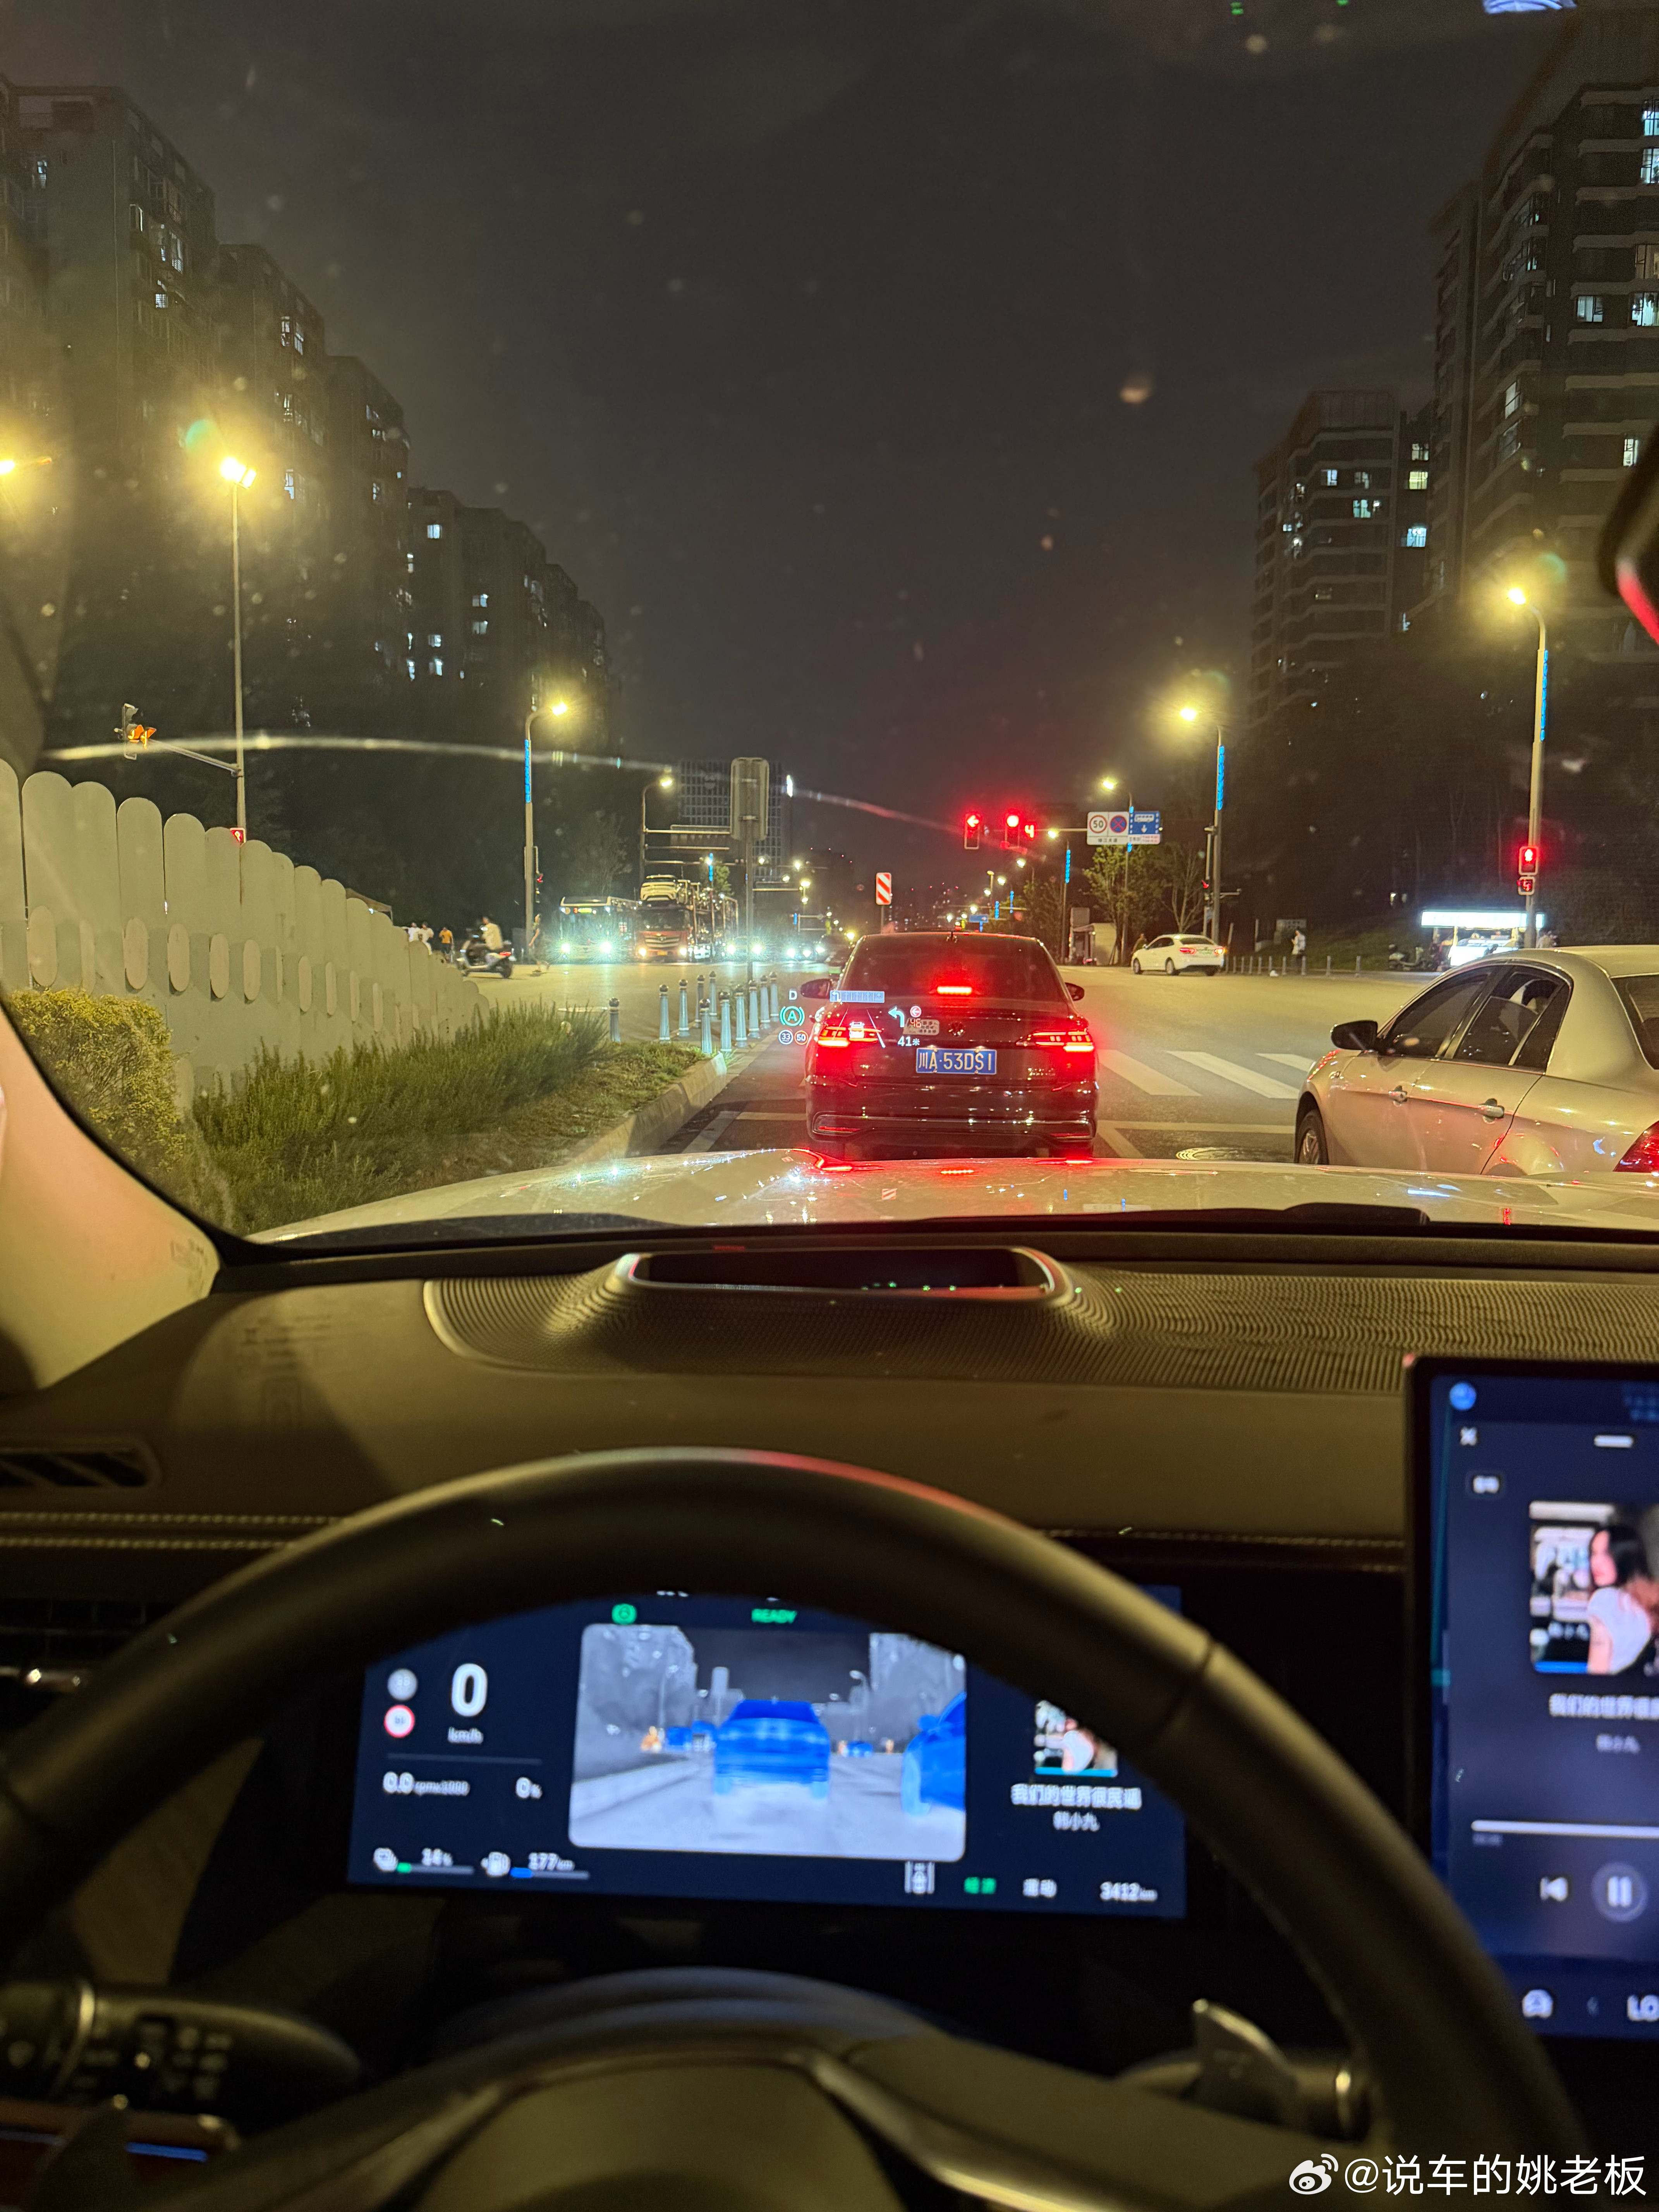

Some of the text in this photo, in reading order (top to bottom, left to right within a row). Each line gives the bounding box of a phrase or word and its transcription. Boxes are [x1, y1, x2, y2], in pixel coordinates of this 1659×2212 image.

[1093, 820, 1104, 828] 50
[789, 990, 797, 1000] D
[910, 1018, 922, 1028] 46
[451, 1663, 488, 1717] 0
